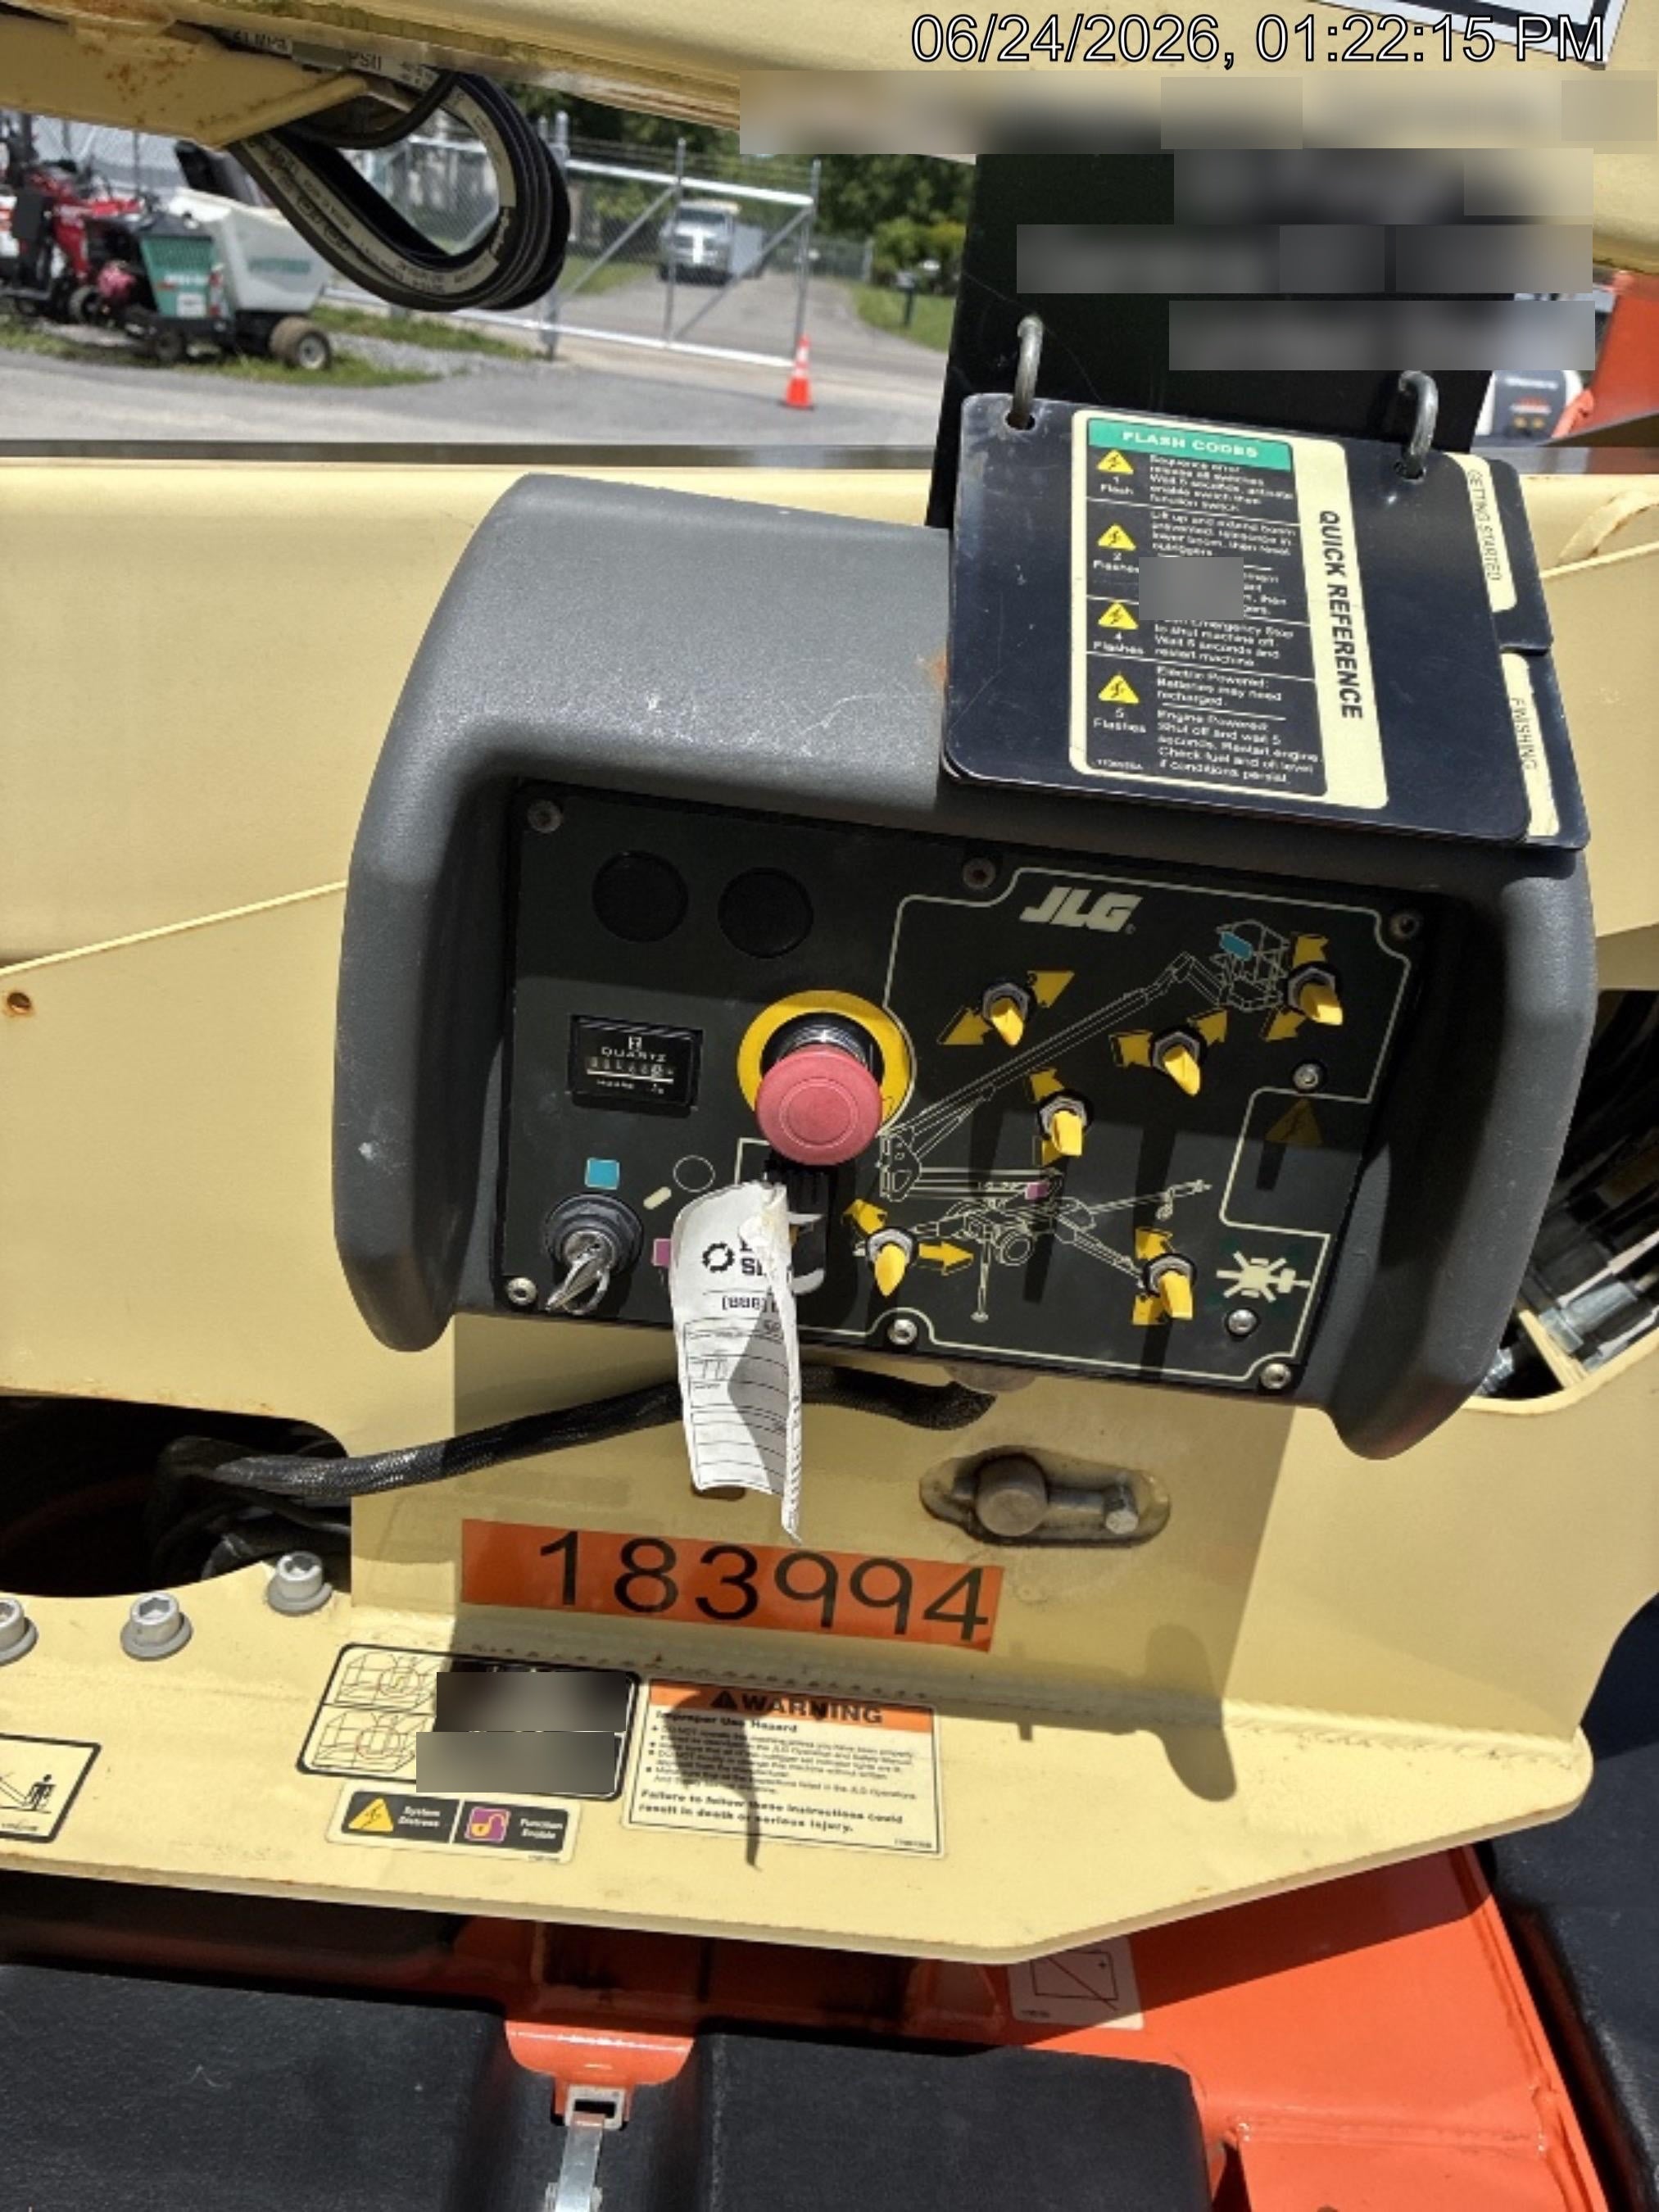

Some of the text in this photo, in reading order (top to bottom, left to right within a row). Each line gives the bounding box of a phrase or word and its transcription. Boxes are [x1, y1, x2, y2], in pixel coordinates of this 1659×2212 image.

[1122, 432, 1258, 459] FLASH CODES
[1100, 483, 1134, 496] Flash
[1467, 469, 1502, 581] GETTING STARTED
[1320, 510, 1364, 718] QUICK REFERENCE
[1093, 641, 1145, 655] Flashes
[1093, 717, 1147, 734] Flashes
[1115, 707, 1125, 719] 5
[1510, 696, 1538, 771] FINISHING
[1020, 886, 1144, 932] JLG
[601, 1045, 666, 1063] QUARTZ
[540, 1530, 989, 1642] 183994
[741, 1693, 883, 1723] WARNING
[639, 1803, 678, 1815] result
[681, 1806, 694, 1815] in
[697, 1808, 734, 1820] death
[755, 1815, 805, 1828] serious
[810, 1819, 854, 1834] injury.
[641, 1789, 903, 1824] Failure to follow these instructions could
[520, 1818, 564, 1829] Function
